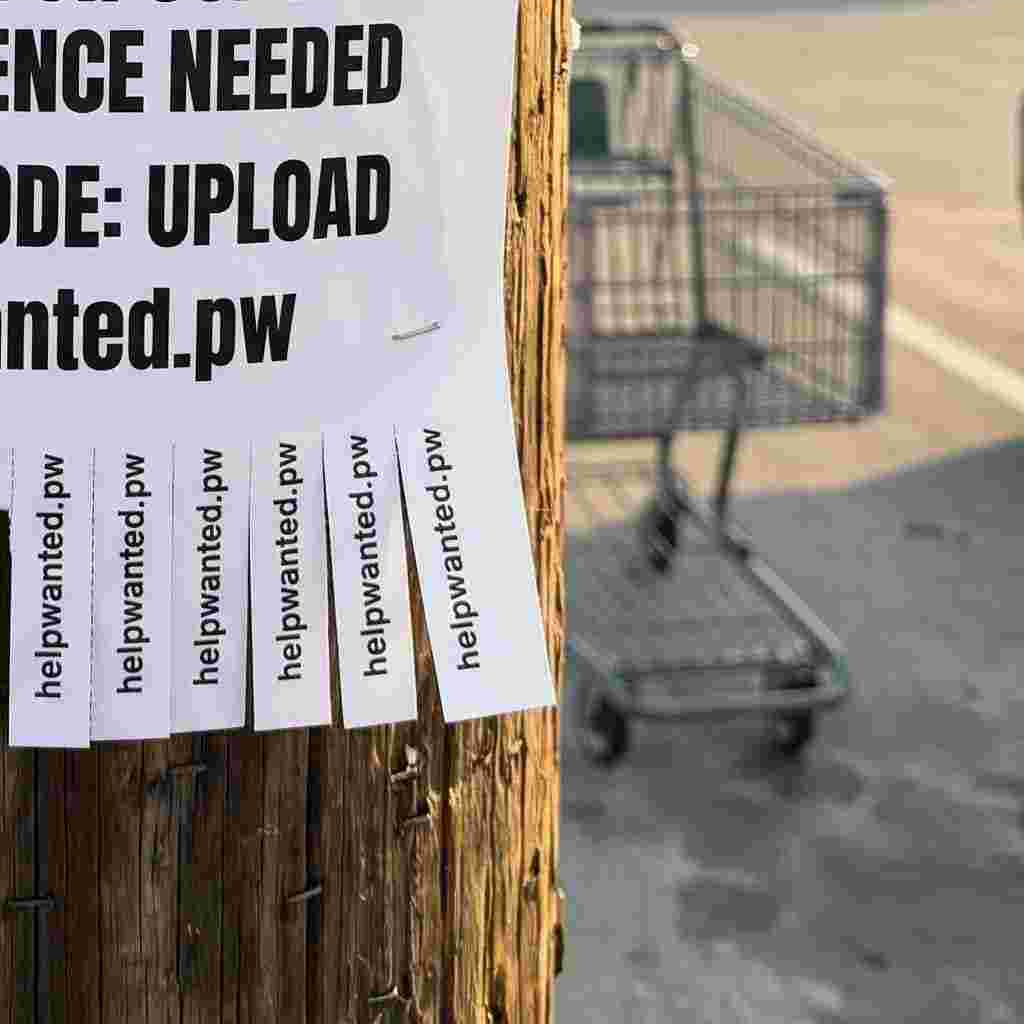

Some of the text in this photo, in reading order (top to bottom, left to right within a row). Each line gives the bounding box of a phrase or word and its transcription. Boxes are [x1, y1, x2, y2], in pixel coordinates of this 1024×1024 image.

[169, 24, 403, 113] NEEDED
[147, 155, 391, 248] UPLOAD
[35, 454, 72, 698] helpwanted.pw
[116, 454, 151, 694] helpwanted.pw
[193, 449, 228, 686] helpwanted.pw
[273, 443, 307, 680] helpwanted.pw
[349, 435, 390, 677] helpwanted.pw
[423, 428, 481, 672] helpwanted.pw
